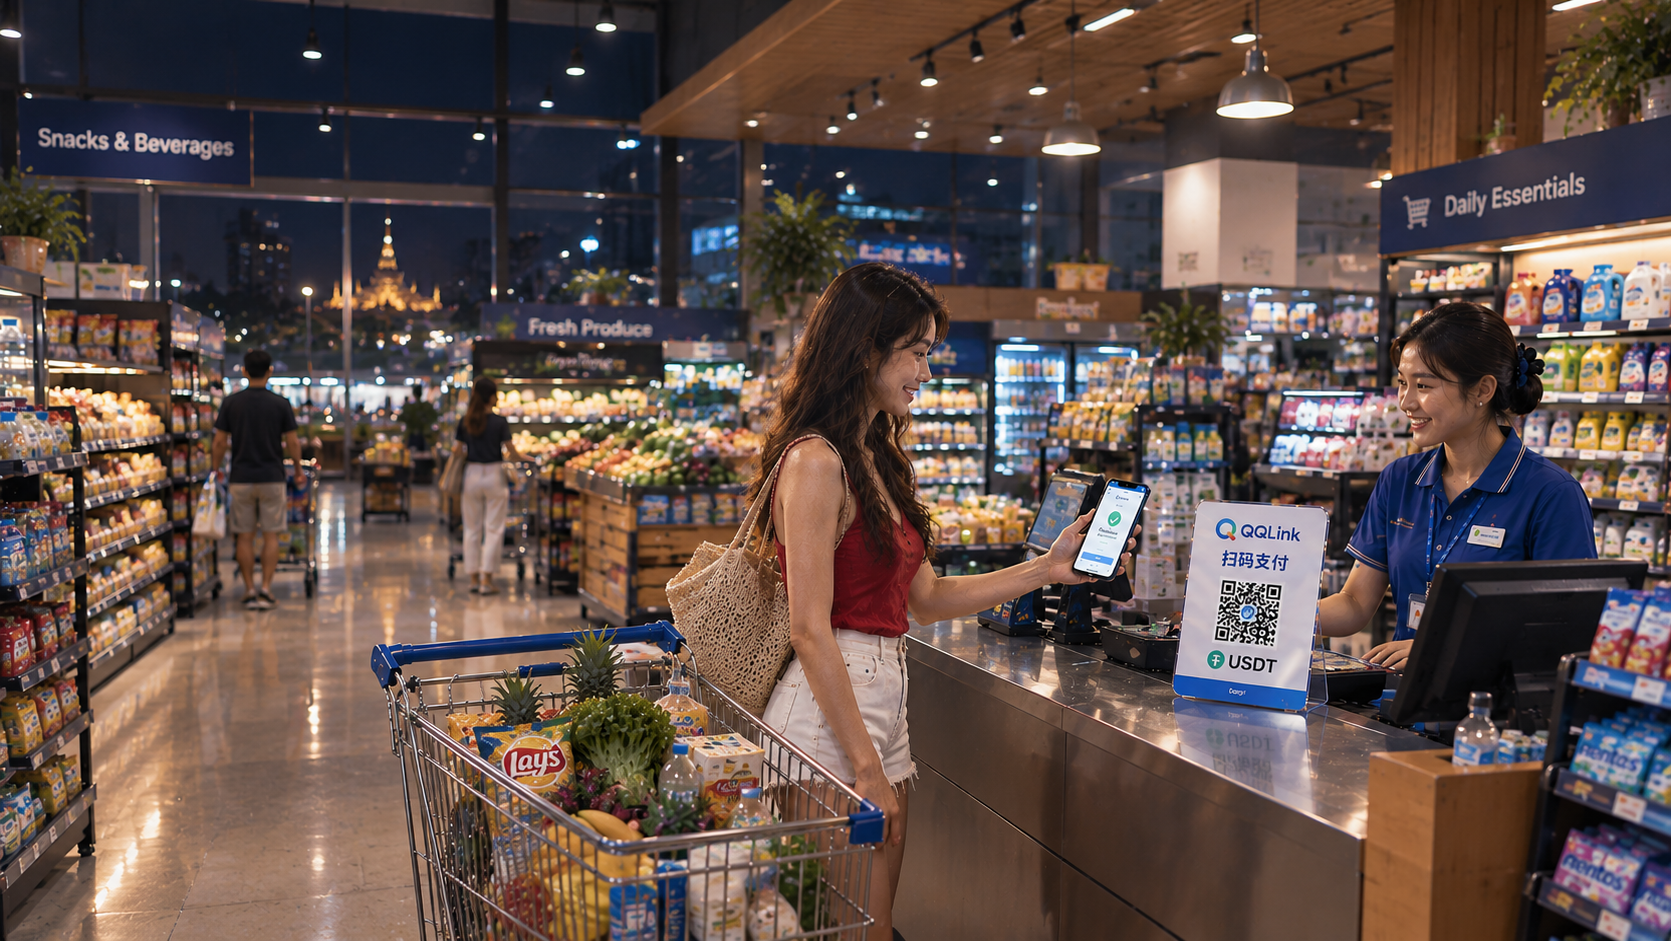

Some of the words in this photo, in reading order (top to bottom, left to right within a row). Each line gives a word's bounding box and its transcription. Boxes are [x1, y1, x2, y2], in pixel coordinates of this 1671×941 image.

[38, 127, 109, 150] Snacks
[114, 131, 129, 151] &
[135, 132, 234, 160] Beverages
[1444, 190, 1487, 218] Daily
[1491, 172, 1586, 209] Essentials
[528, 317, 578, 336] Fresh
[581, 318, 653, 338] Produce
[1241, 524, 1300, 542] QQLink
[1222, 550, 1289, 572] 扫码支付
[1228, 654, 1278, 673] USDT
